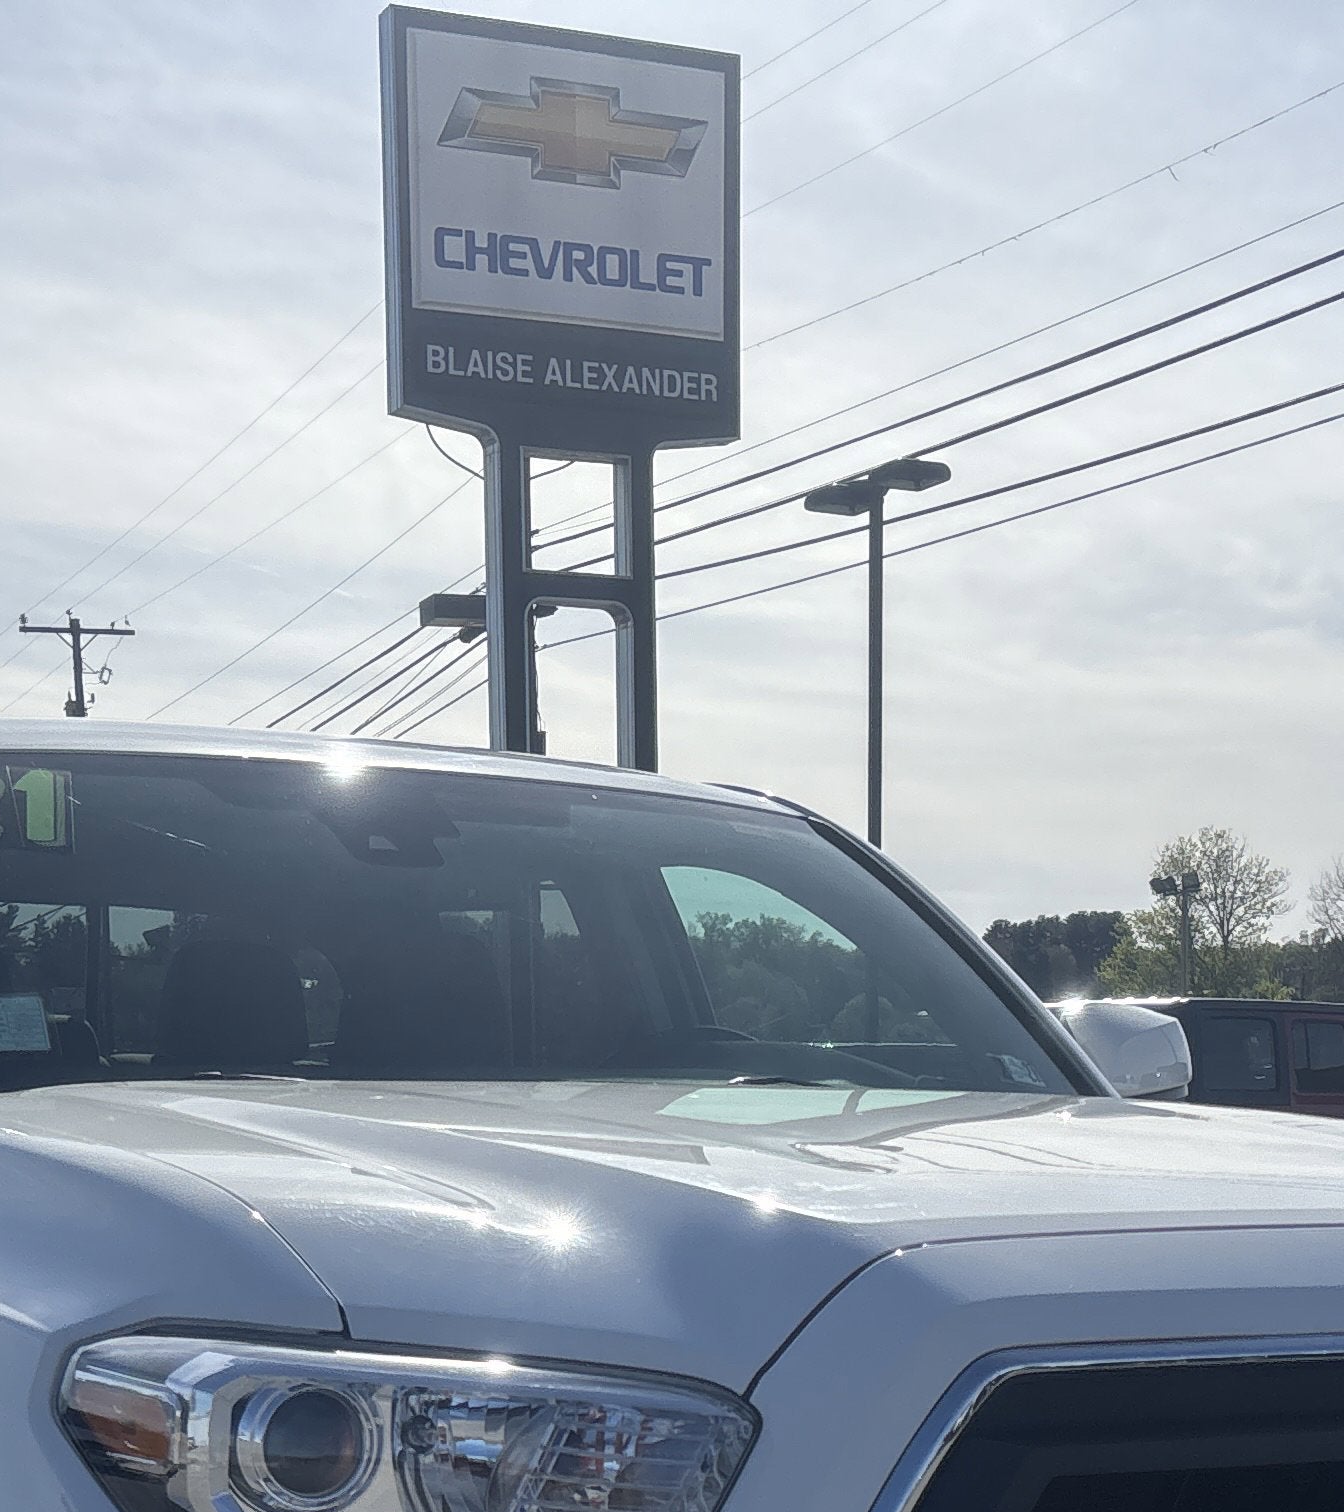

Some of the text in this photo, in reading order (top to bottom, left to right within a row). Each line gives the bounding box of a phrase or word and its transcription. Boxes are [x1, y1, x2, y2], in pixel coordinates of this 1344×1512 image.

[433, 226, 713, 298] CHEVROLET
[425, 343, 719, 403] BLAISE ALEXANDER
